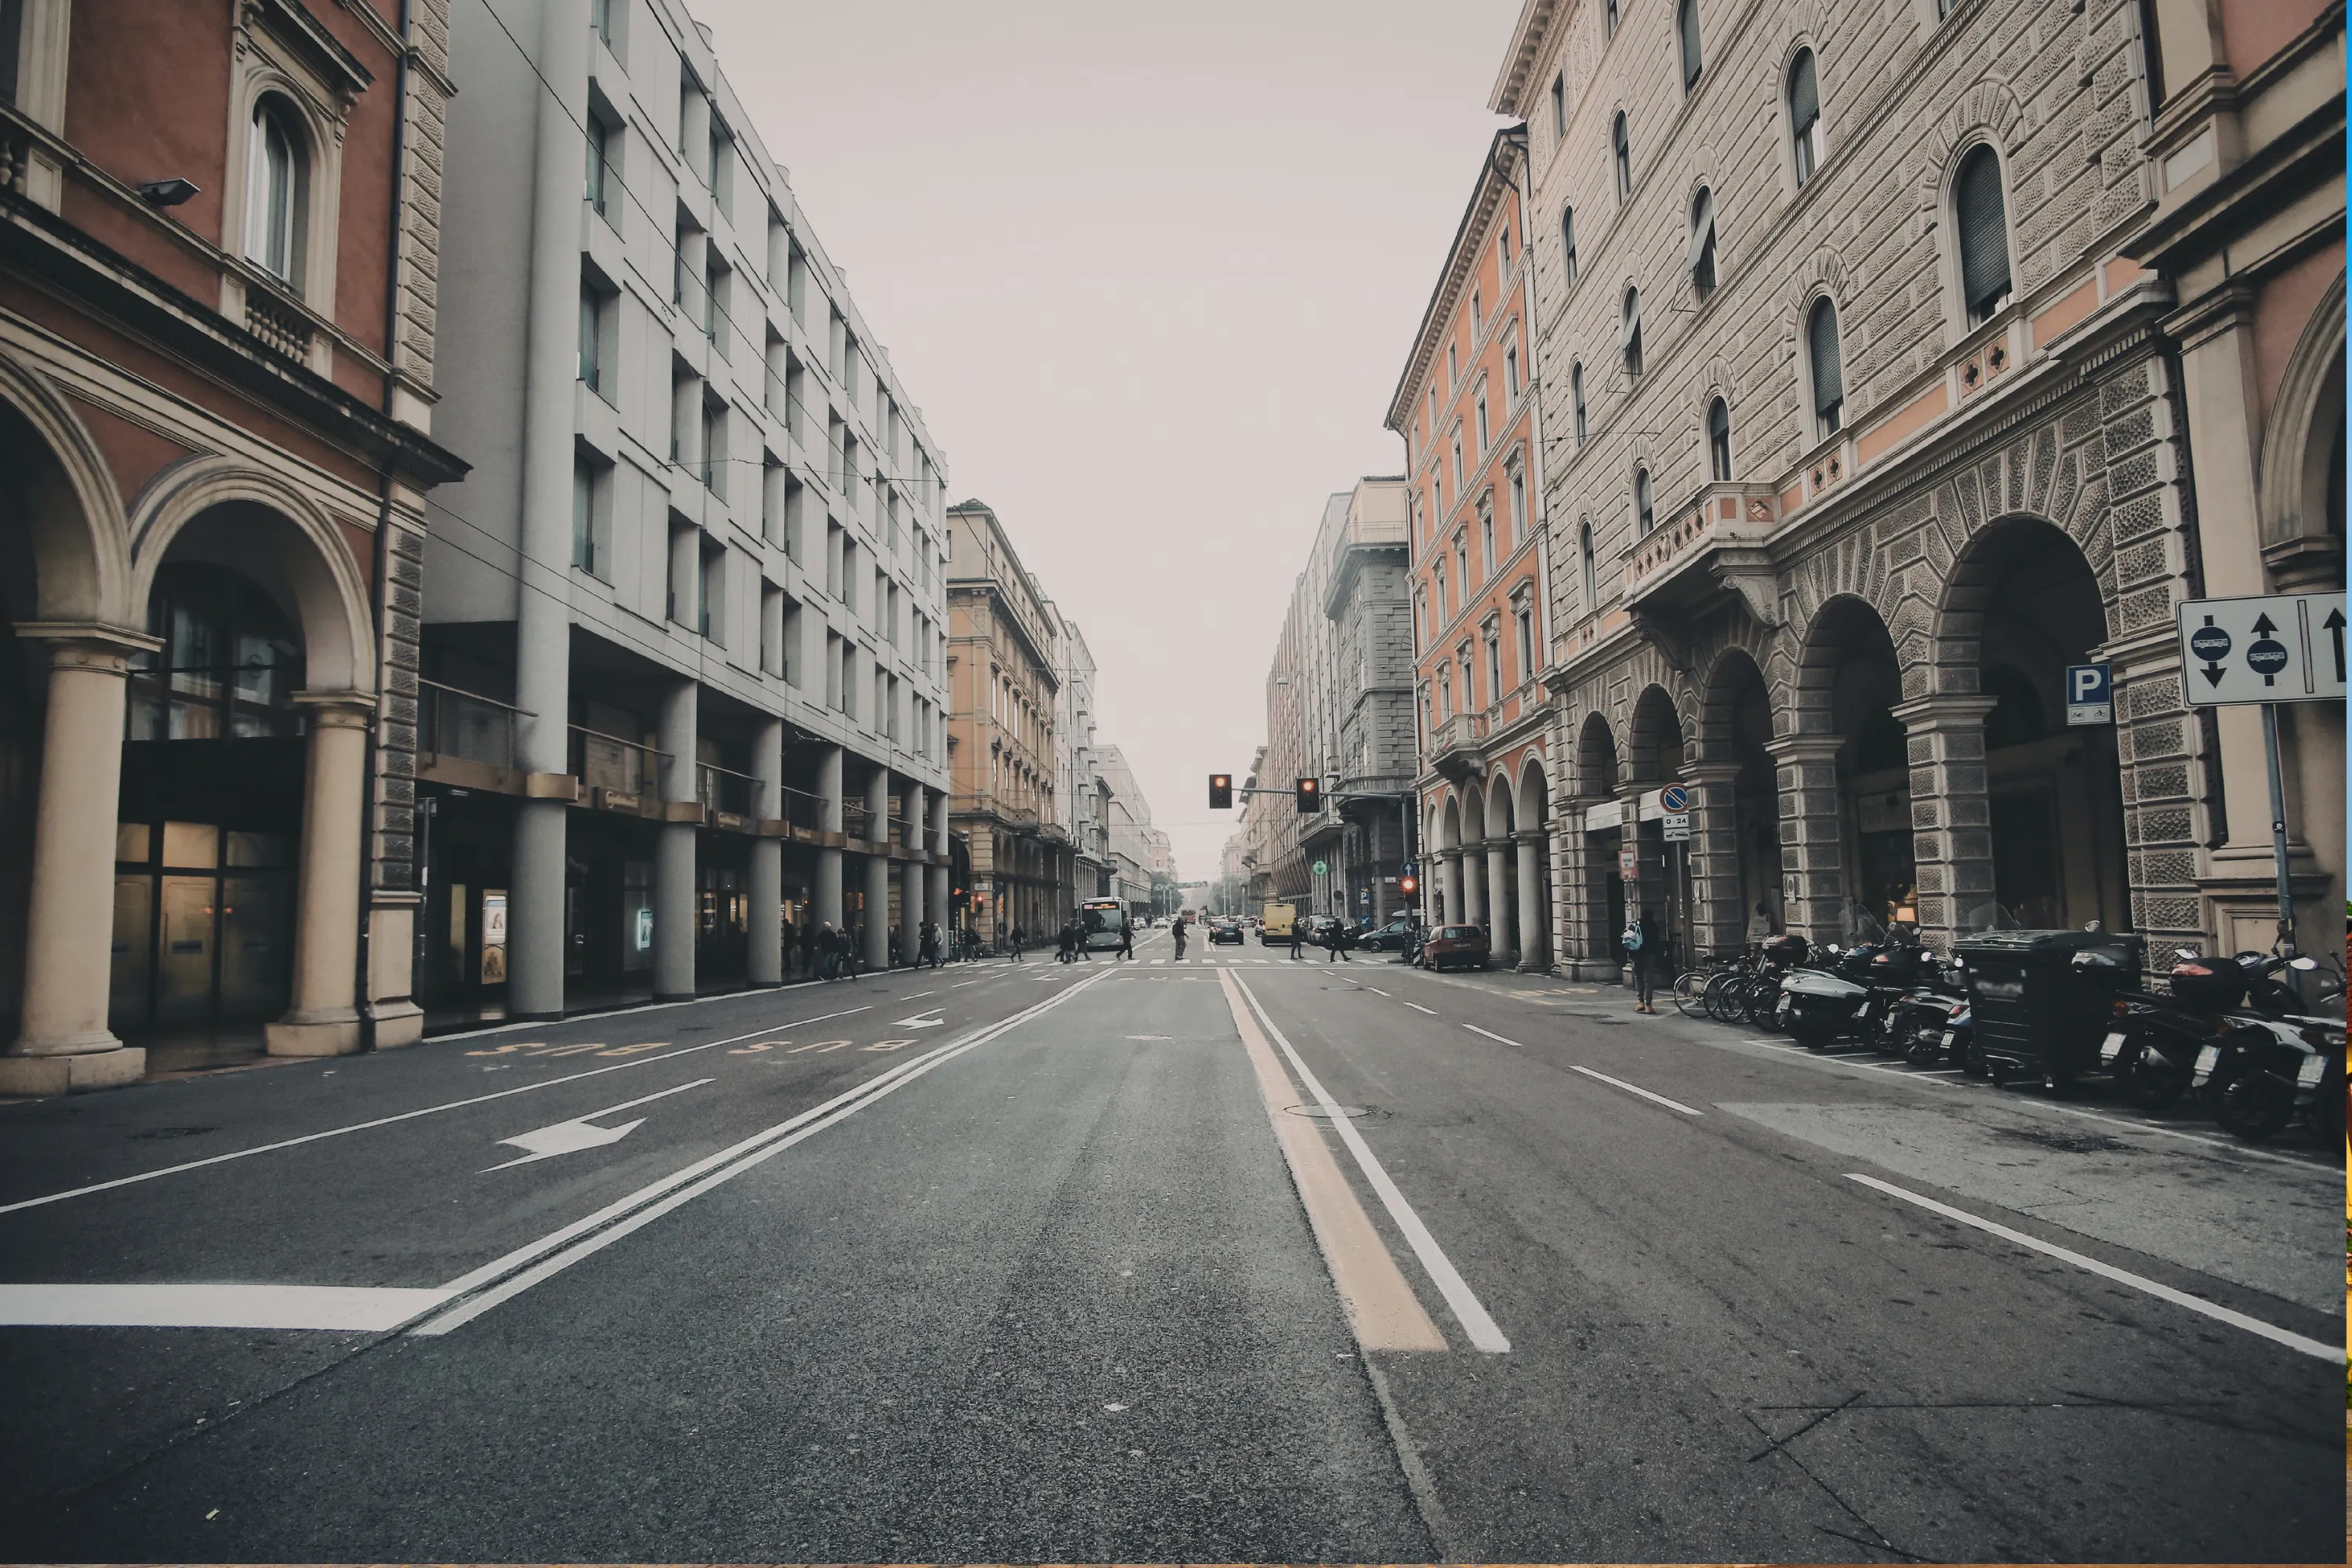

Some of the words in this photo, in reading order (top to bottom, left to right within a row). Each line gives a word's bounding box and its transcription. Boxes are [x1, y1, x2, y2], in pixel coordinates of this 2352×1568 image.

[2075, 669, 2101, 701] P
[464, 1042, 672, 1056] BUS
[727, 1039, 920, 1054] BUS
